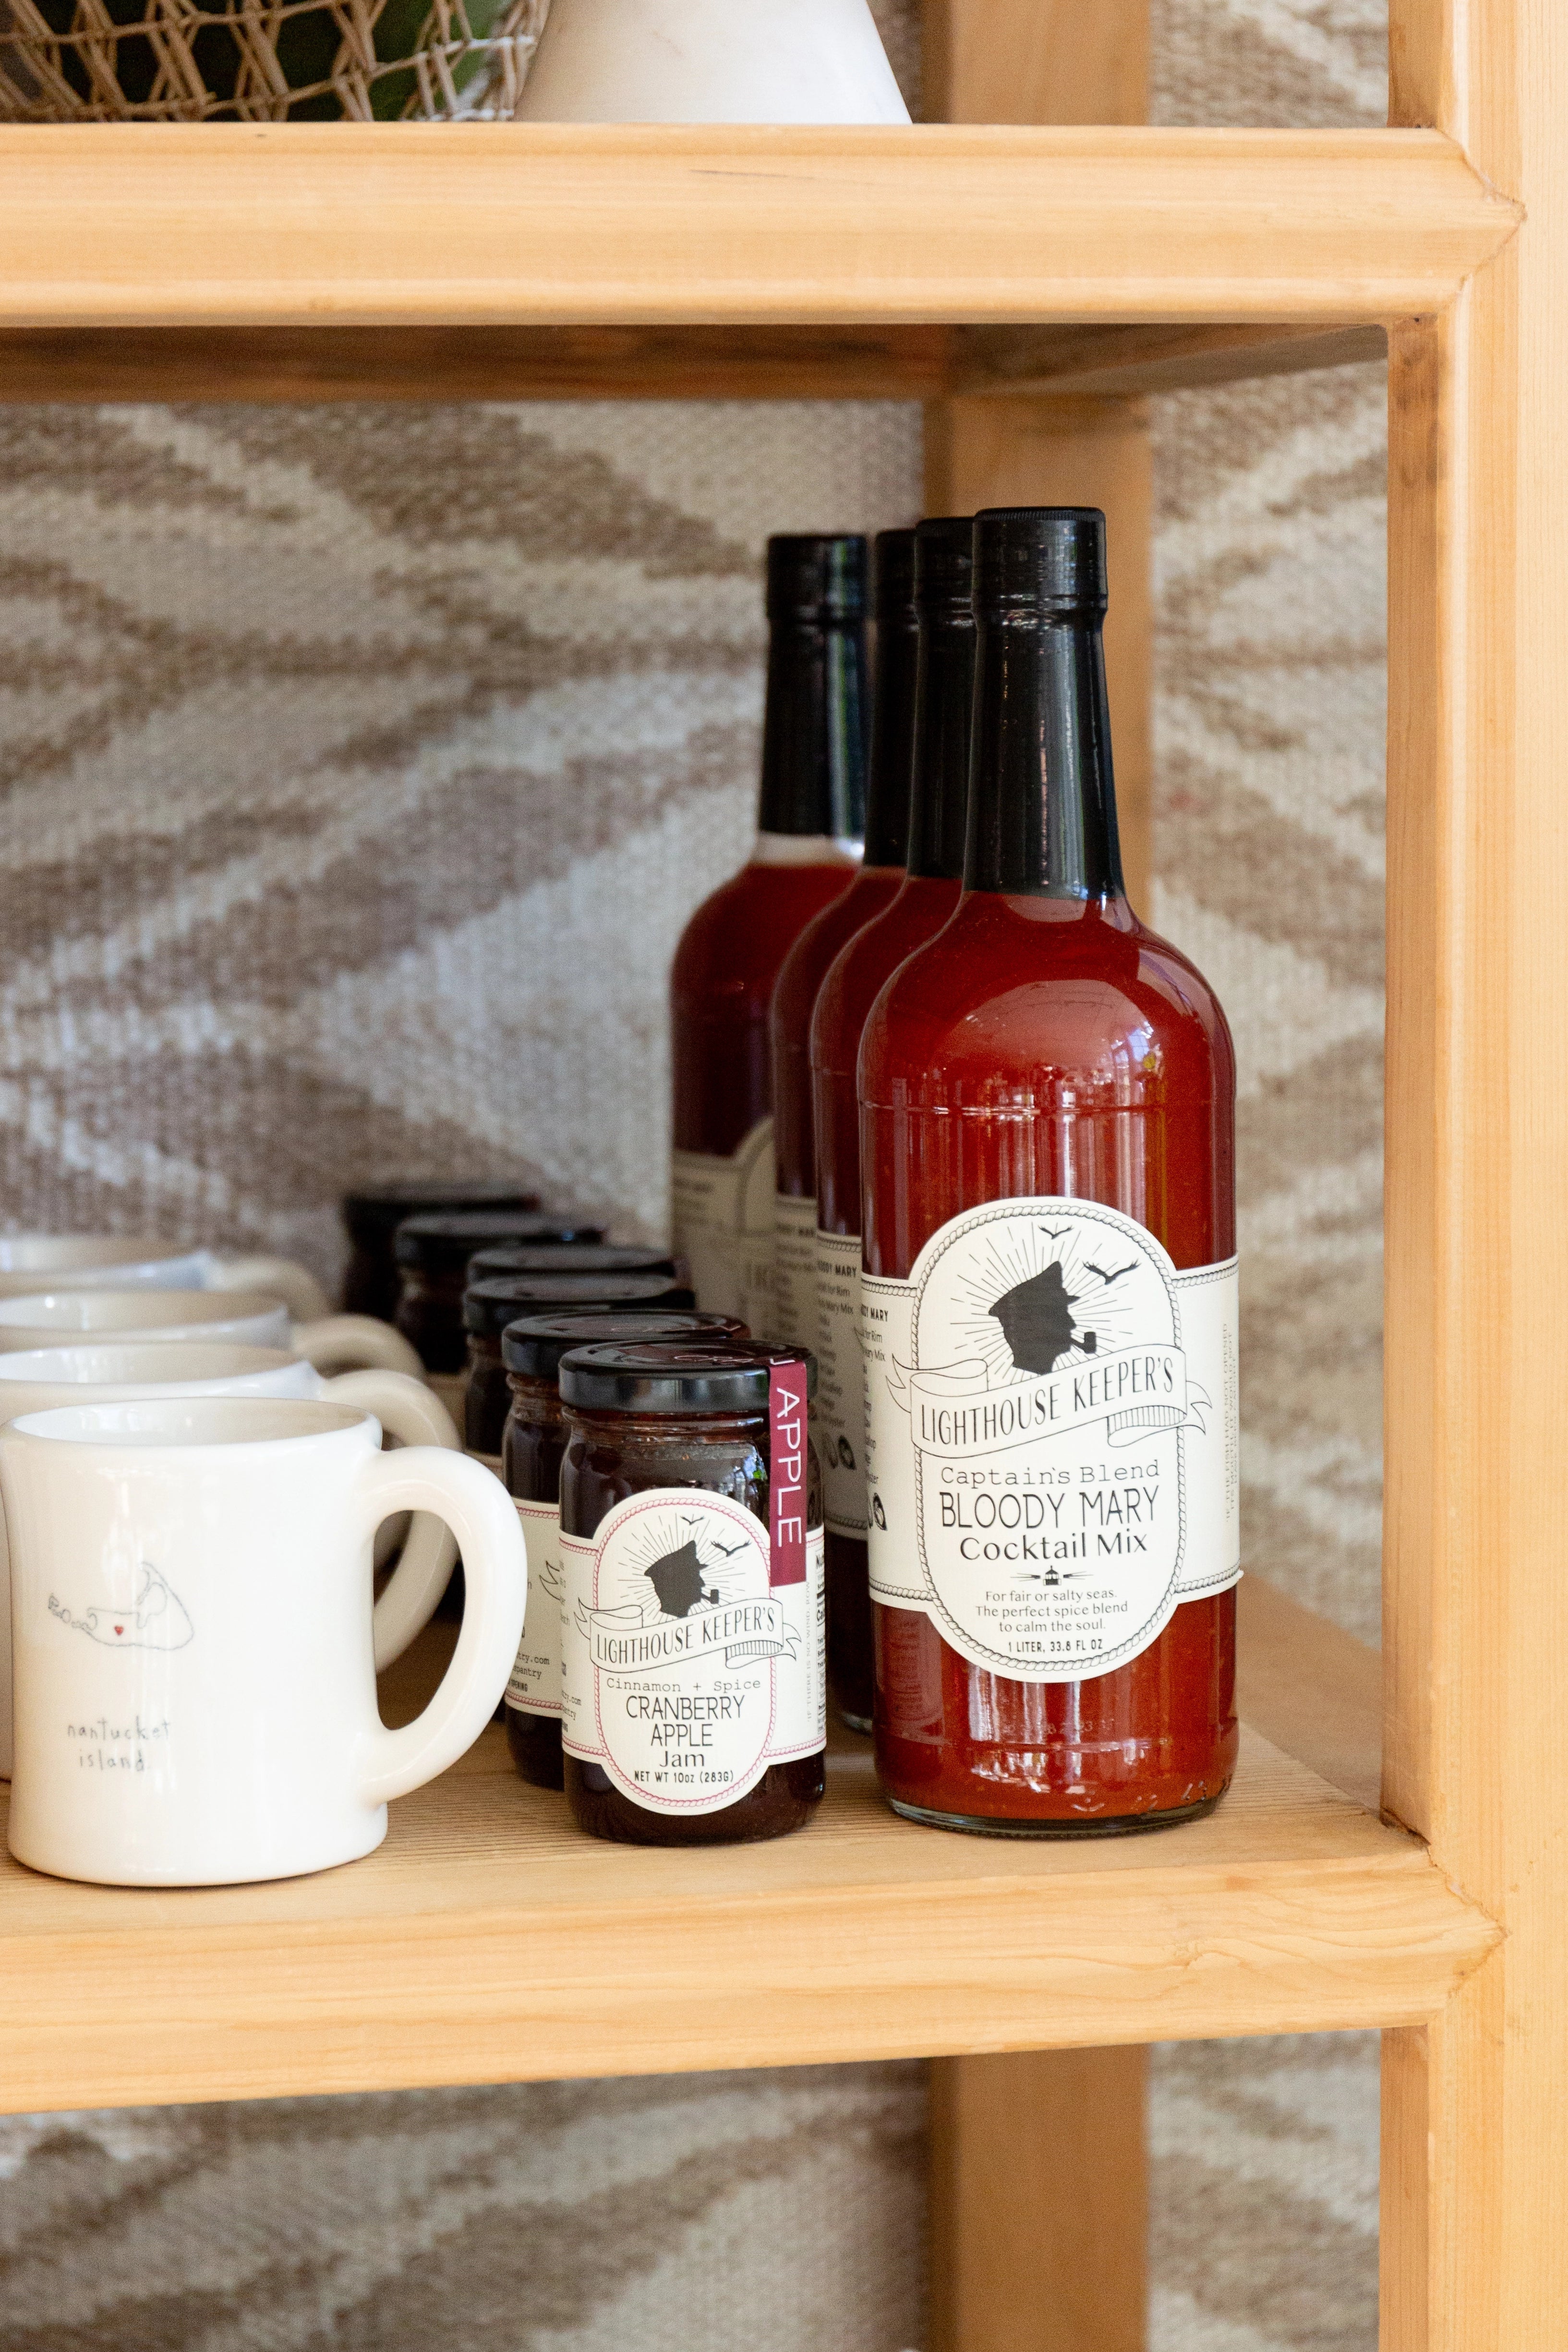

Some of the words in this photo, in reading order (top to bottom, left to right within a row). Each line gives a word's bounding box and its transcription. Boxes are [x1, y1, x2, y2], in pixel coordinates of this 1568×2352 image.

[870, 1307, 888, 1322] MARY
[921, 1383, 1061, 1445] LIGHTHOUSE
[1074, 1356, 1173, 1412] KEEPER'S
[776, 1387, 802, 1547] APPLE
[1080, 1459, 1159, 1483] Blend
[939, 1492, 1065, 1529] BLOODY
[1079, 1485, 1159, 1527] MARY
[960, 1532, 1086, 1561] Cocktail
[1097, 1528, 1147, 1556] Mix
[986, 1591, 1006, 1601] For
[1010, 1590, 1032, 1602] fair
[1035, 1593, 1049, 1602] or
[1052, 1590, 1083, 1603] salty
[1086, 1590, 1117, 1600] seas.
[976, 1605, 999, 1617] The
[1002, 1605, 1050, 1619] perfect
[1054, 1605, 1089, 1618] spice
[1093, 1601, 1128, 1614] blend
[597, 1624, 694, 1664] LIGHTHOUSE
[703, 1606, 775, 1644] KEEPER'S
[999, 1622, 1013, 1632] to
[1015, 1621, 1047, 1632] calm
[1051, 1620, 1072, 1632] the
[1076, 1618, 1106, 1630] soul.
[806, 1642, 810, 1657] NO
[1008, 1641, 1012, 1652] 1
[1016, 1641, 1045, 1653] LITER,
[1050, 1640, 1072, 1652] 33.8
[1076, 1640, 1086, 1651] FL
[1091, 1638, 1103, 1650] OZ
[606, 1677, 681, 1692] Cinnamon
[713, 1679, 761, 1694] Spice
[626, 1695, 745, 1720] CRANBERRY
[67, 1715, 171, 1741] nantucket
[651, 1723, 713, 1747] APPLE
[79, 1749, 145, 1773] island
[659, 1750, 705, 1768] Jam
[634, 1770, 650, 1782] NET
[654, 1772, 669, 1783] WT
[674, 1772, 694, 1783] 10oz
[700, 1770, 734, 1784] (283G)
